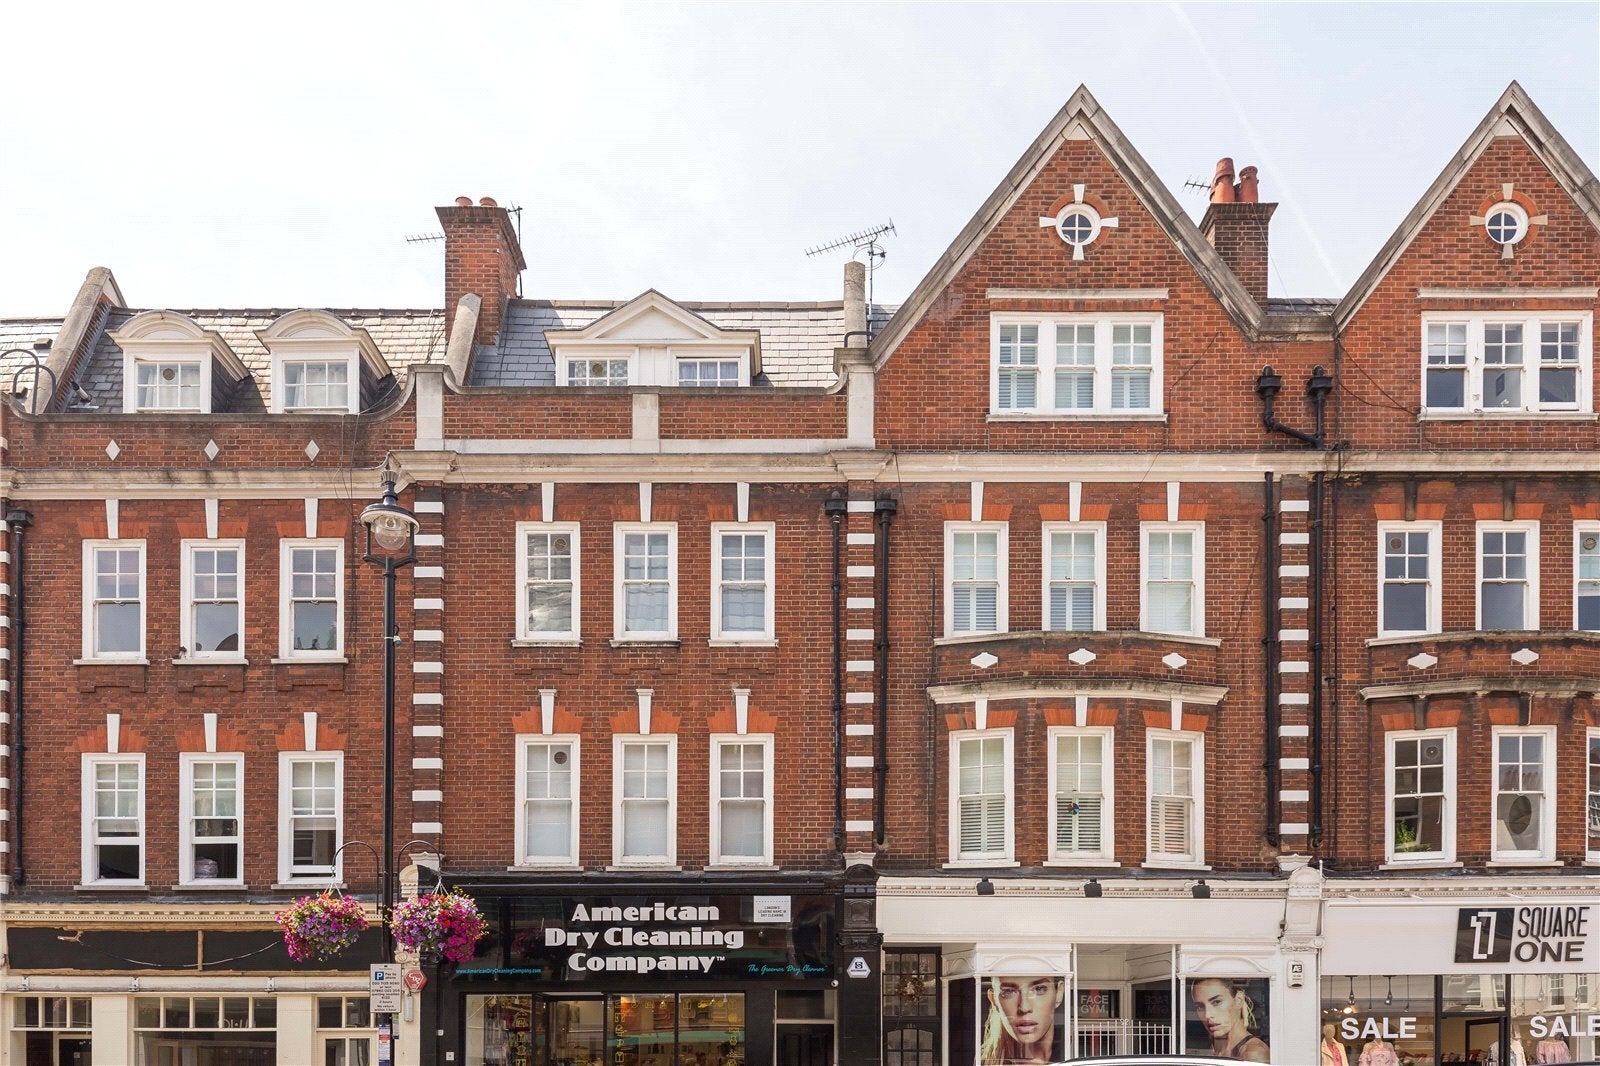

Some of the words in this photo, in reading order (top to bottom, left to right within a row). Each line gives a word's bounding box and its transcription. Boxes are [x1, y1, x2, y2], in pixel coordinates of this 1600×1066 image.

[572, 903, 719, 921] American
[1517, 906, 1591, 943] SQUARE
[545, 928, 599, 949] Dry
[604, 927, 744, 949] Cleaning
[1515, 941, 1585, 963] ONE
[748, 964, 759, 972] The
[761, 965, 784, 975] Greener
[786, 965, 801, 976] Dry
[1081, 995, 1109, 1005] FACE
[1342, 1018, 1417, 1040] SALE
[1530, 1015, 1600, 1038] SALE
